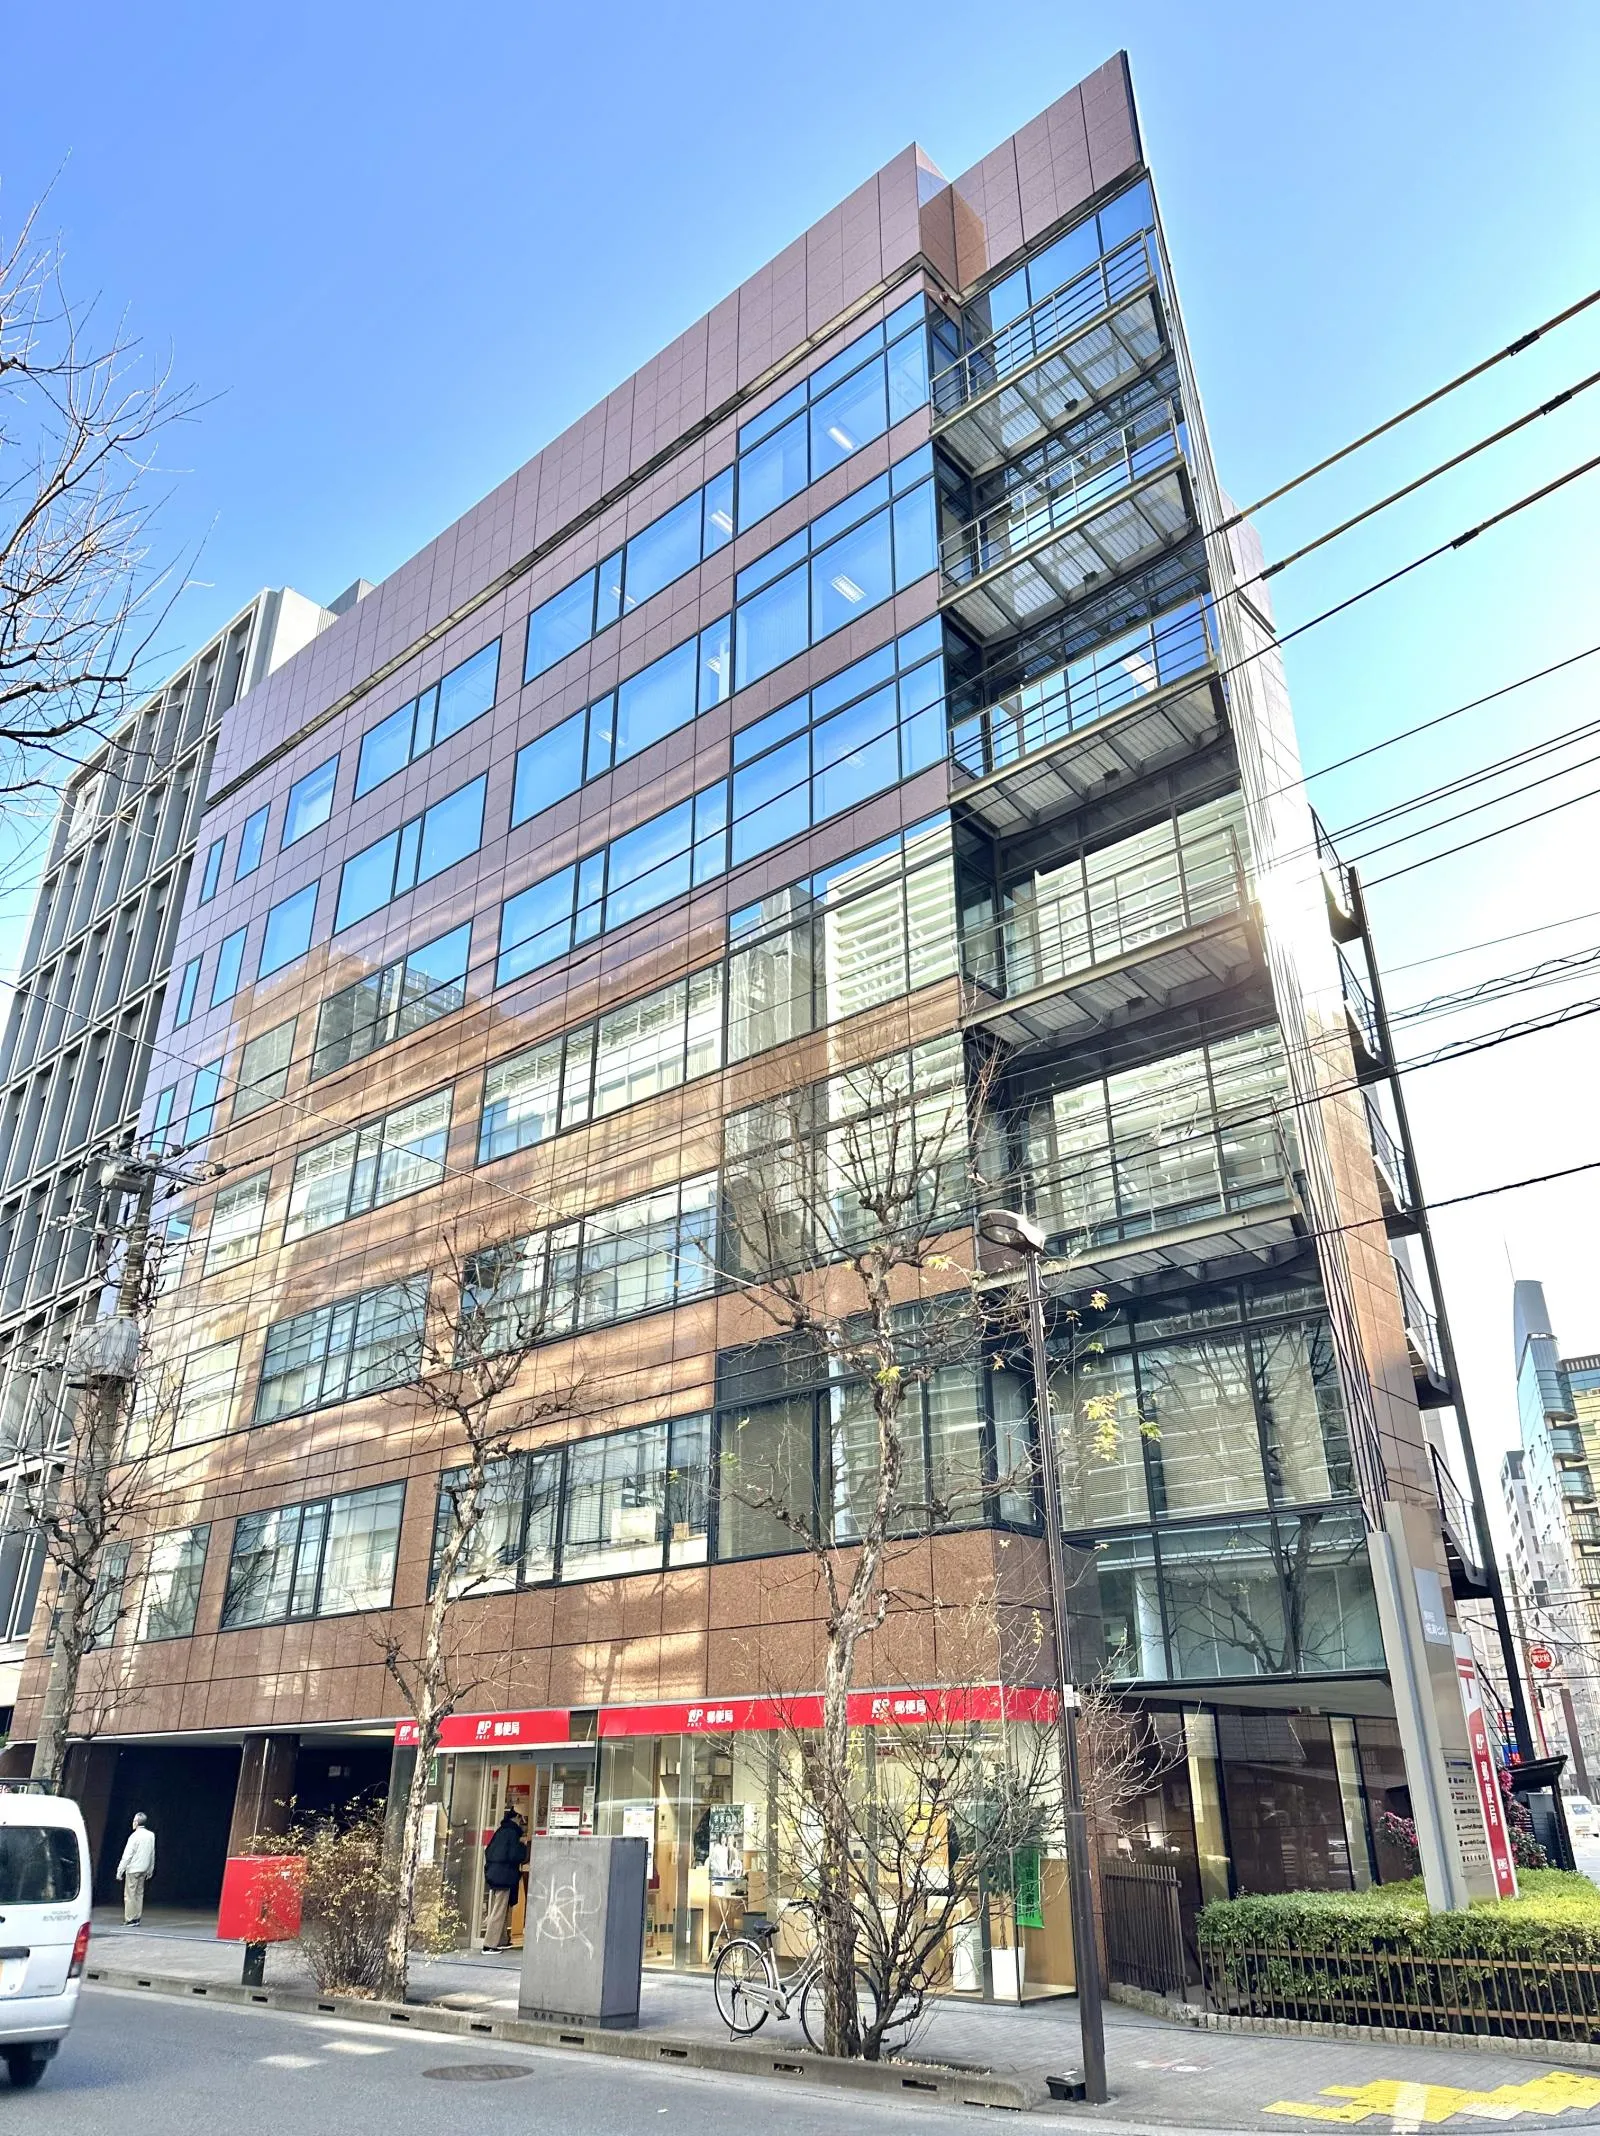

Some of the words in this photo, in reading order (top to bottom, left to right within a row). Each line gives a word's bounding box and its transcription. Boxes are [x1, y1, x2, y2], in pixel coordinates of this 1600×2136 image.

[894, 1699, 927, 1715] 郵便局
[688, 1708, 704, 1723] JP
[706, 1709, 734, 1724] 郵便局
[476, 1720, 492, 1735] JP
[494, 1721, 520, 1736] 郵便局
[1480, 1760, 1499, 1826] 郵便局
